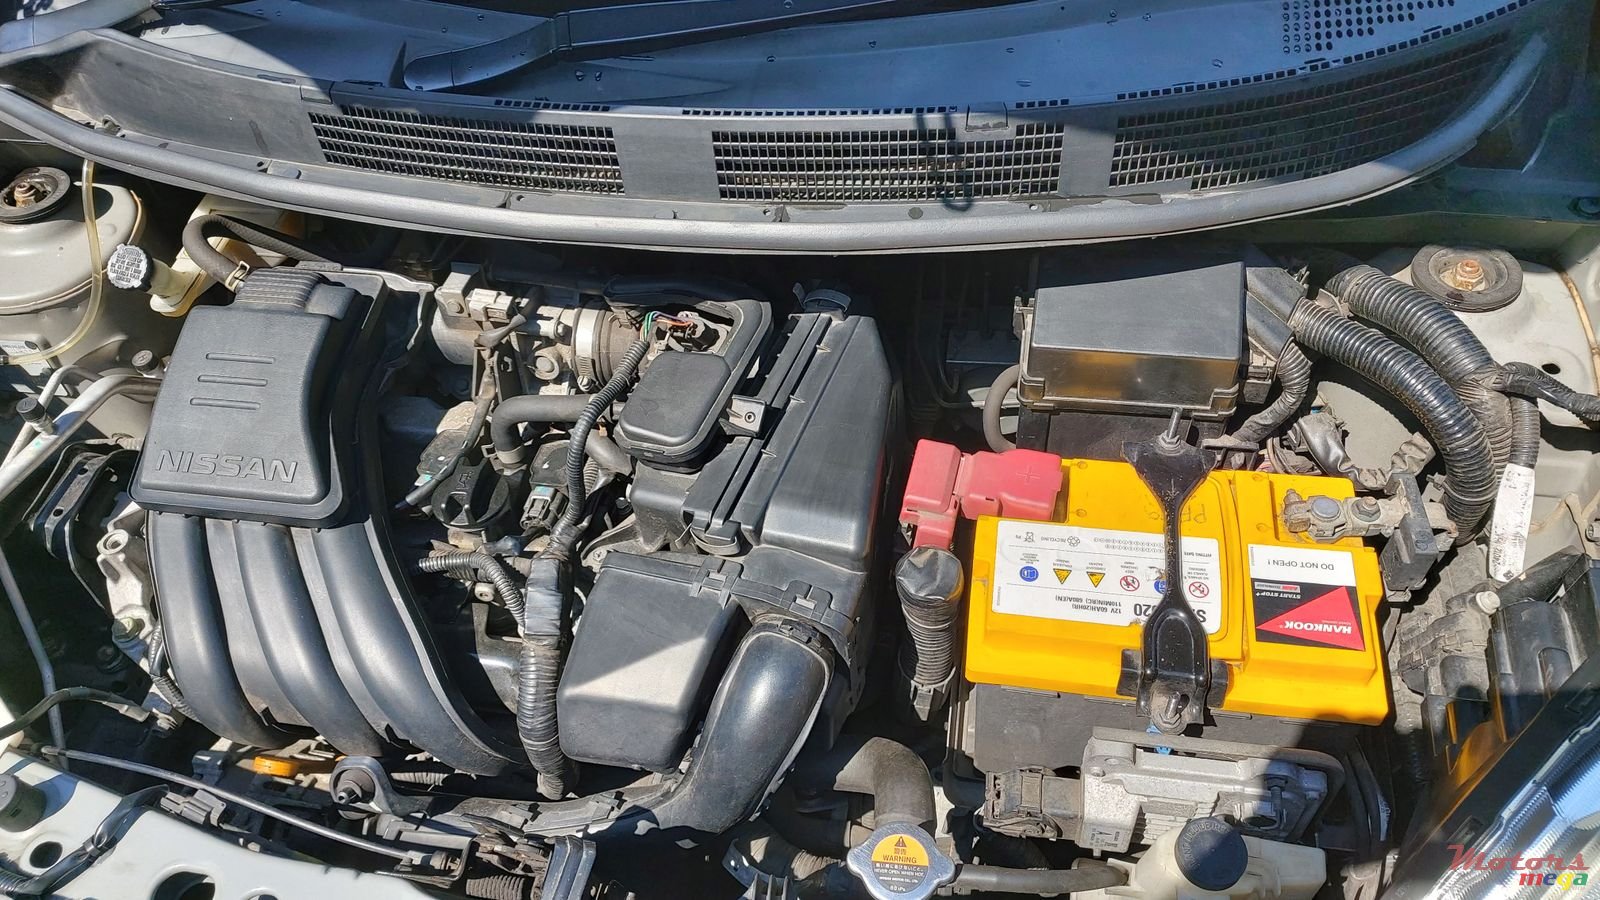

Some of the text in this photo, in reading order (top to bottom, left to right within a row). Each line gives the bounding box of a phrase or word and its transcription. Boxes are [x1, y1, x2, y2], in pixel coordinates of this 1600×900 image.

[155, 449, 298, 484] NISSAN
[1272, 559, 1297, 567] OPEN
[1300, 561, 1318, 569] NOT
[1320, 563, 1334, 571] DO
[1284, 620, 1352, 634] HANKOOK
[882, 854, 917, 864] WARNING
